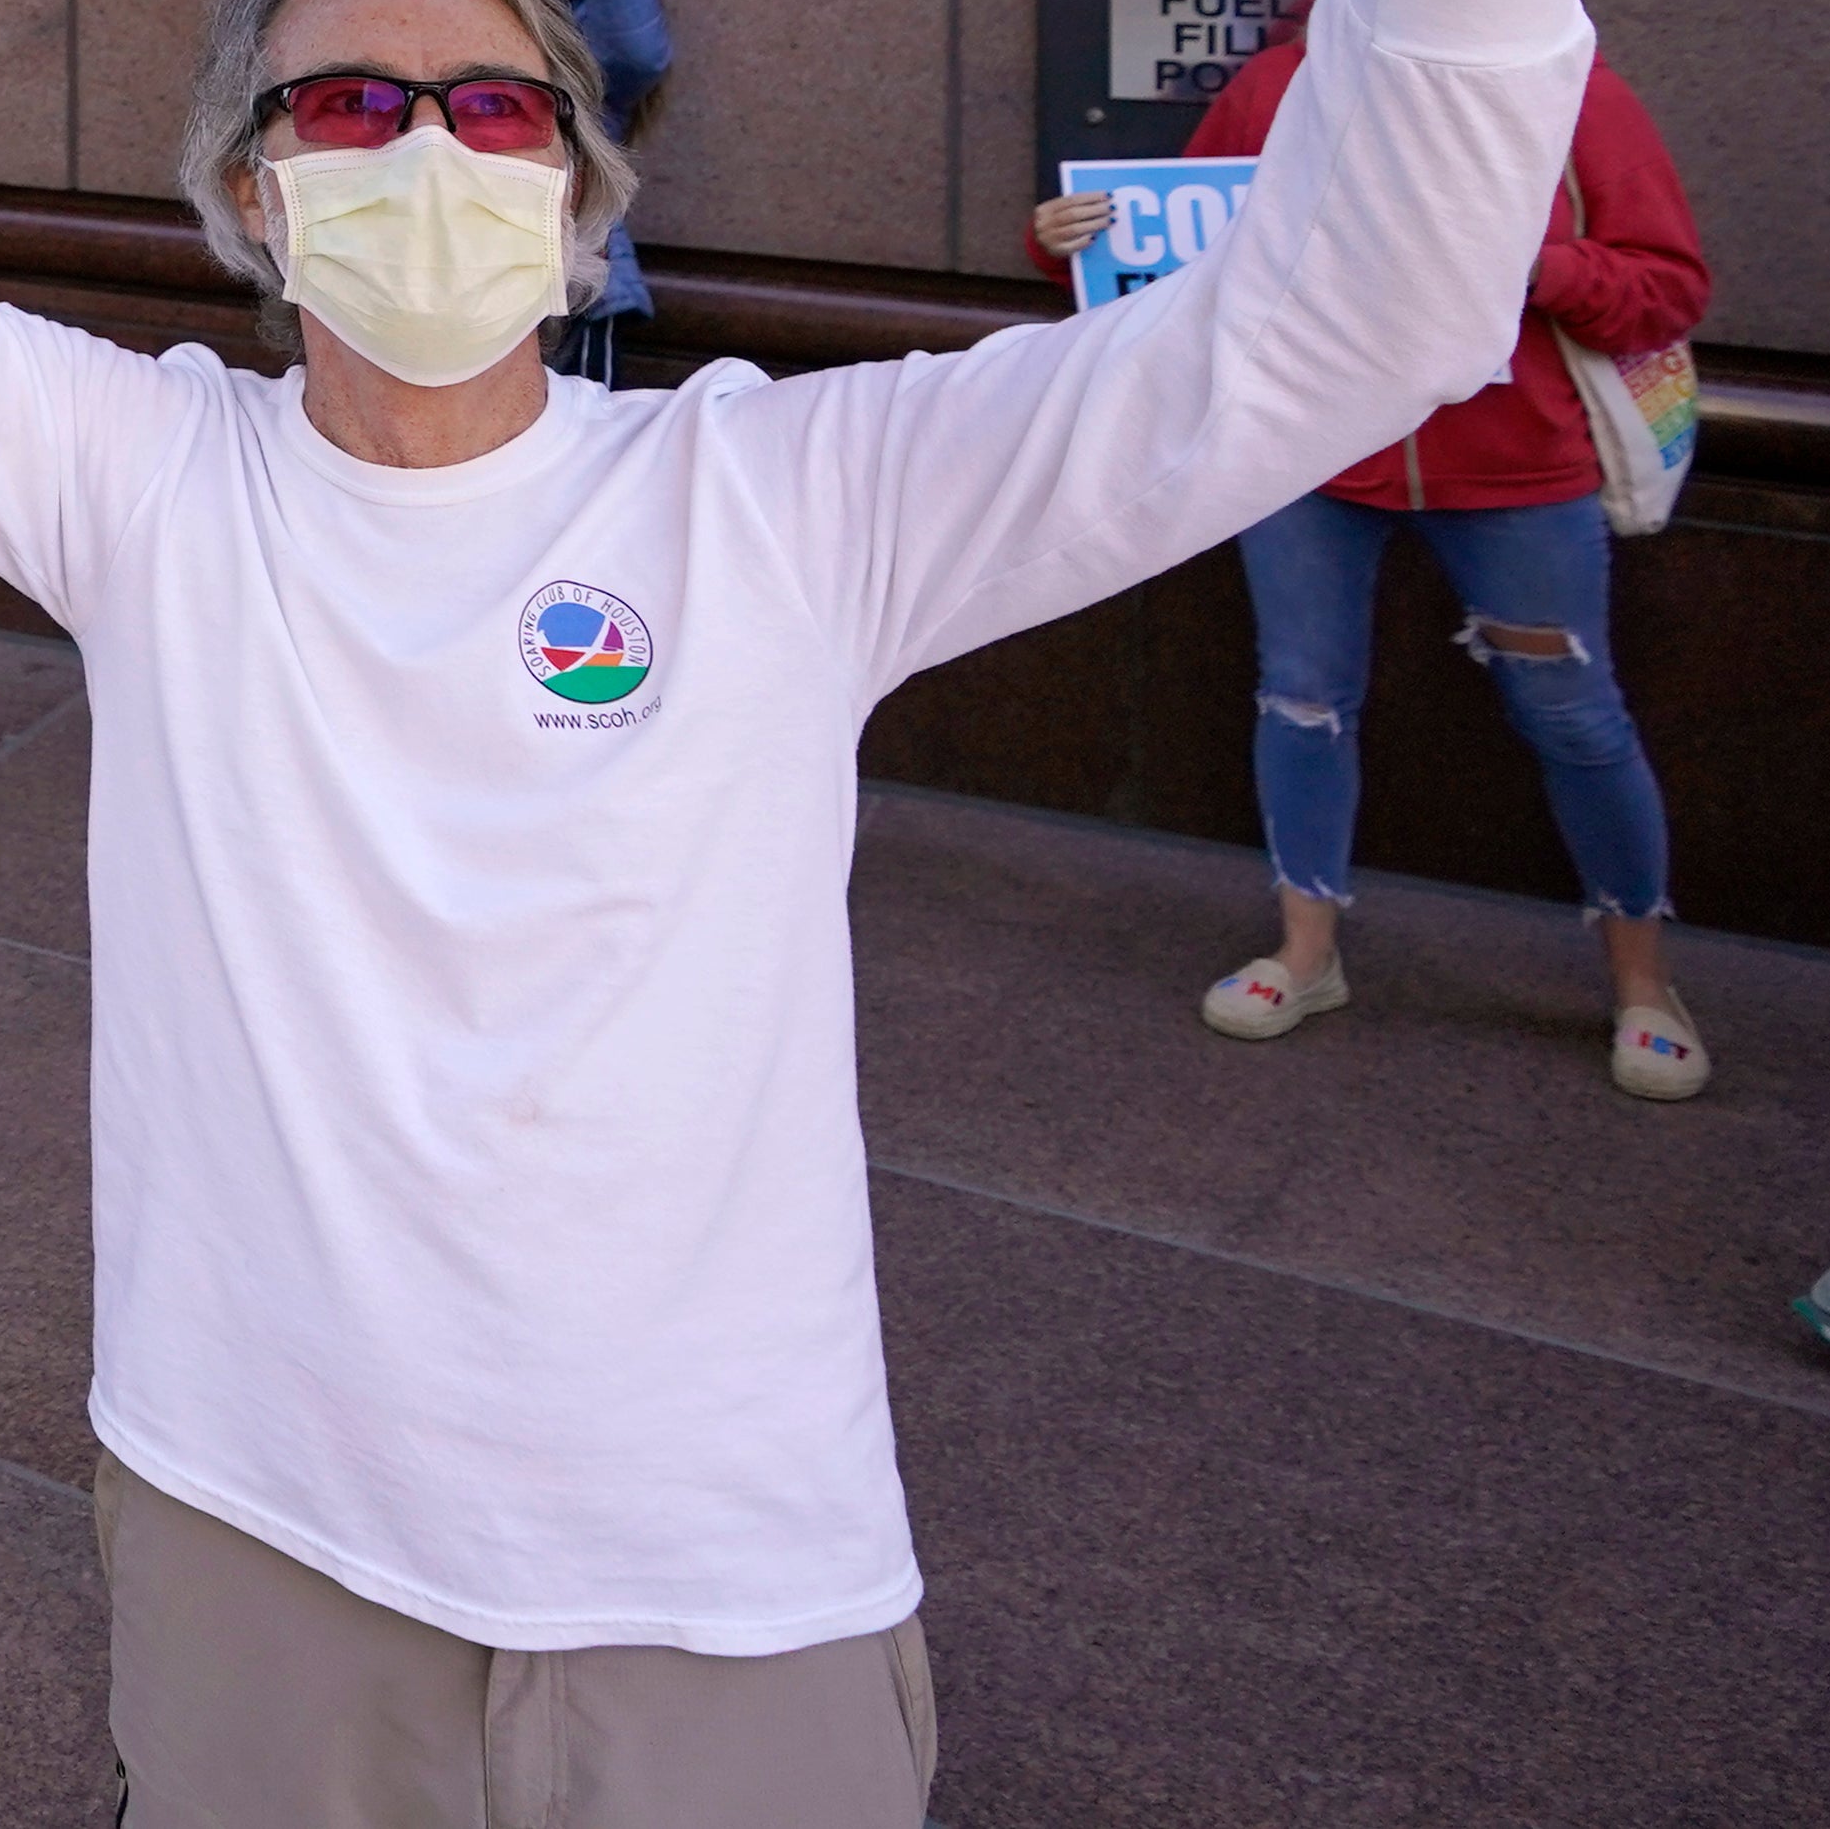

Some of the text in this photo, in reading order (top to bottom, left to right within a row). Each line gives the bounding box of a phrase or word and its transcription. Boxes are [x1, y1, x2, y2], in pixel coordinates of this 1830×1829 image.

[1155, 60, 1245, 93] PO
[522, 585, 647, 678] SOARING CLUB OF HOUSTON
[532, 695, 663, 730] www.scoh.org
